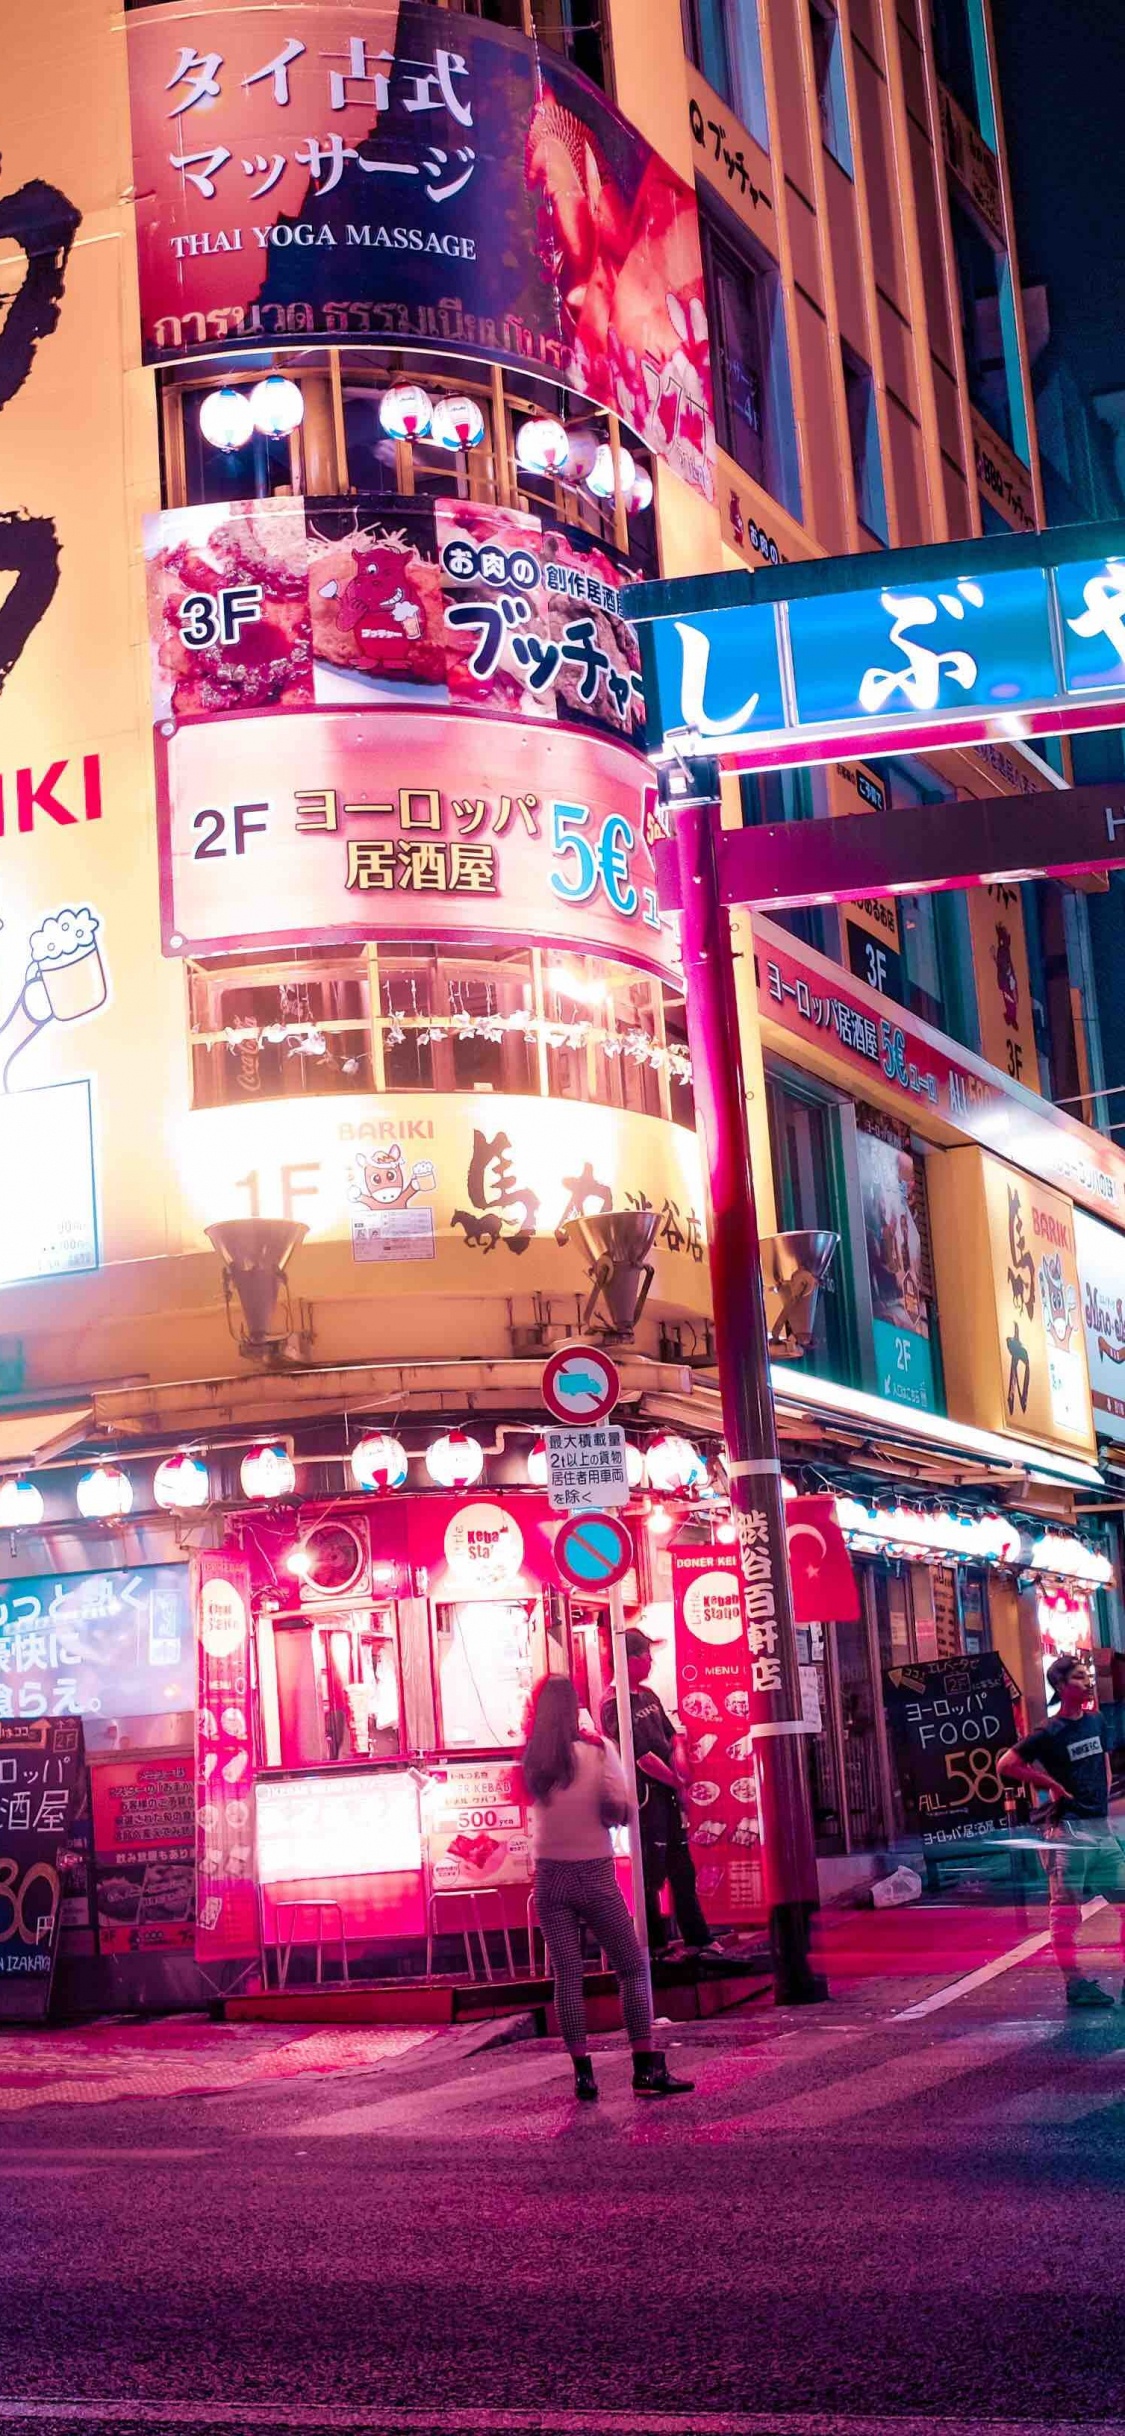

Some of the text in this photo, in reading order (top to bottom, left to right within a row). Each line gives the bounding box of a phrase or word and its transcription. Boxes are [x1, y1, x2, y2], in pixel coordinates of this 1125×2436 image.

[166, 36, 473, 127] タイ古式
[168, 132, 476, 203] マッサージ
[171, 224, 477, 261] THAI YOGA MASSAGE
[447, 545, 537, 587] お肉の
[180, 587, 261, 649] 3F
[0, 755, 102, 838] KI
[294, 788, 540, 838] ヨーロッパ
[192, 802, 269, 860] 2F
[345, 839, 498, 893] 居酒屋
[548, 803, 635, 915] 5€
[866, 943, 886, 992] 3F
[767, 961, 880, 1061] ヨーロッパ居酒屋
[1007, 1039, 1022, 1081] 3F
[340, 1119, 434, 1141] BARIKI
[1031, 1206, 1072, 1252] BARIKI
[895, 1337, 911, 1372] 2F
[550, 1432, 621, 1450] 最大積載量
[550, 1450, 623, 1469] 2t以上の貨物
[551, 1468, 624, 1487] 居住者用車両
[553, 1489, 593, 1505] を除く
[677, 1556, 714, 1569] DONER
[737, 1509, 782, 1692] 渋谷百軒店
[705, 1666, 739, 1675] MENU
[905, 1692, 987, 1721] ヨーロッパ
[919, 1715, 1000, 1749] FOOD
[474, 1782, 511, 1794] KEBAB
[458, 1810, 497, 1829] 500
